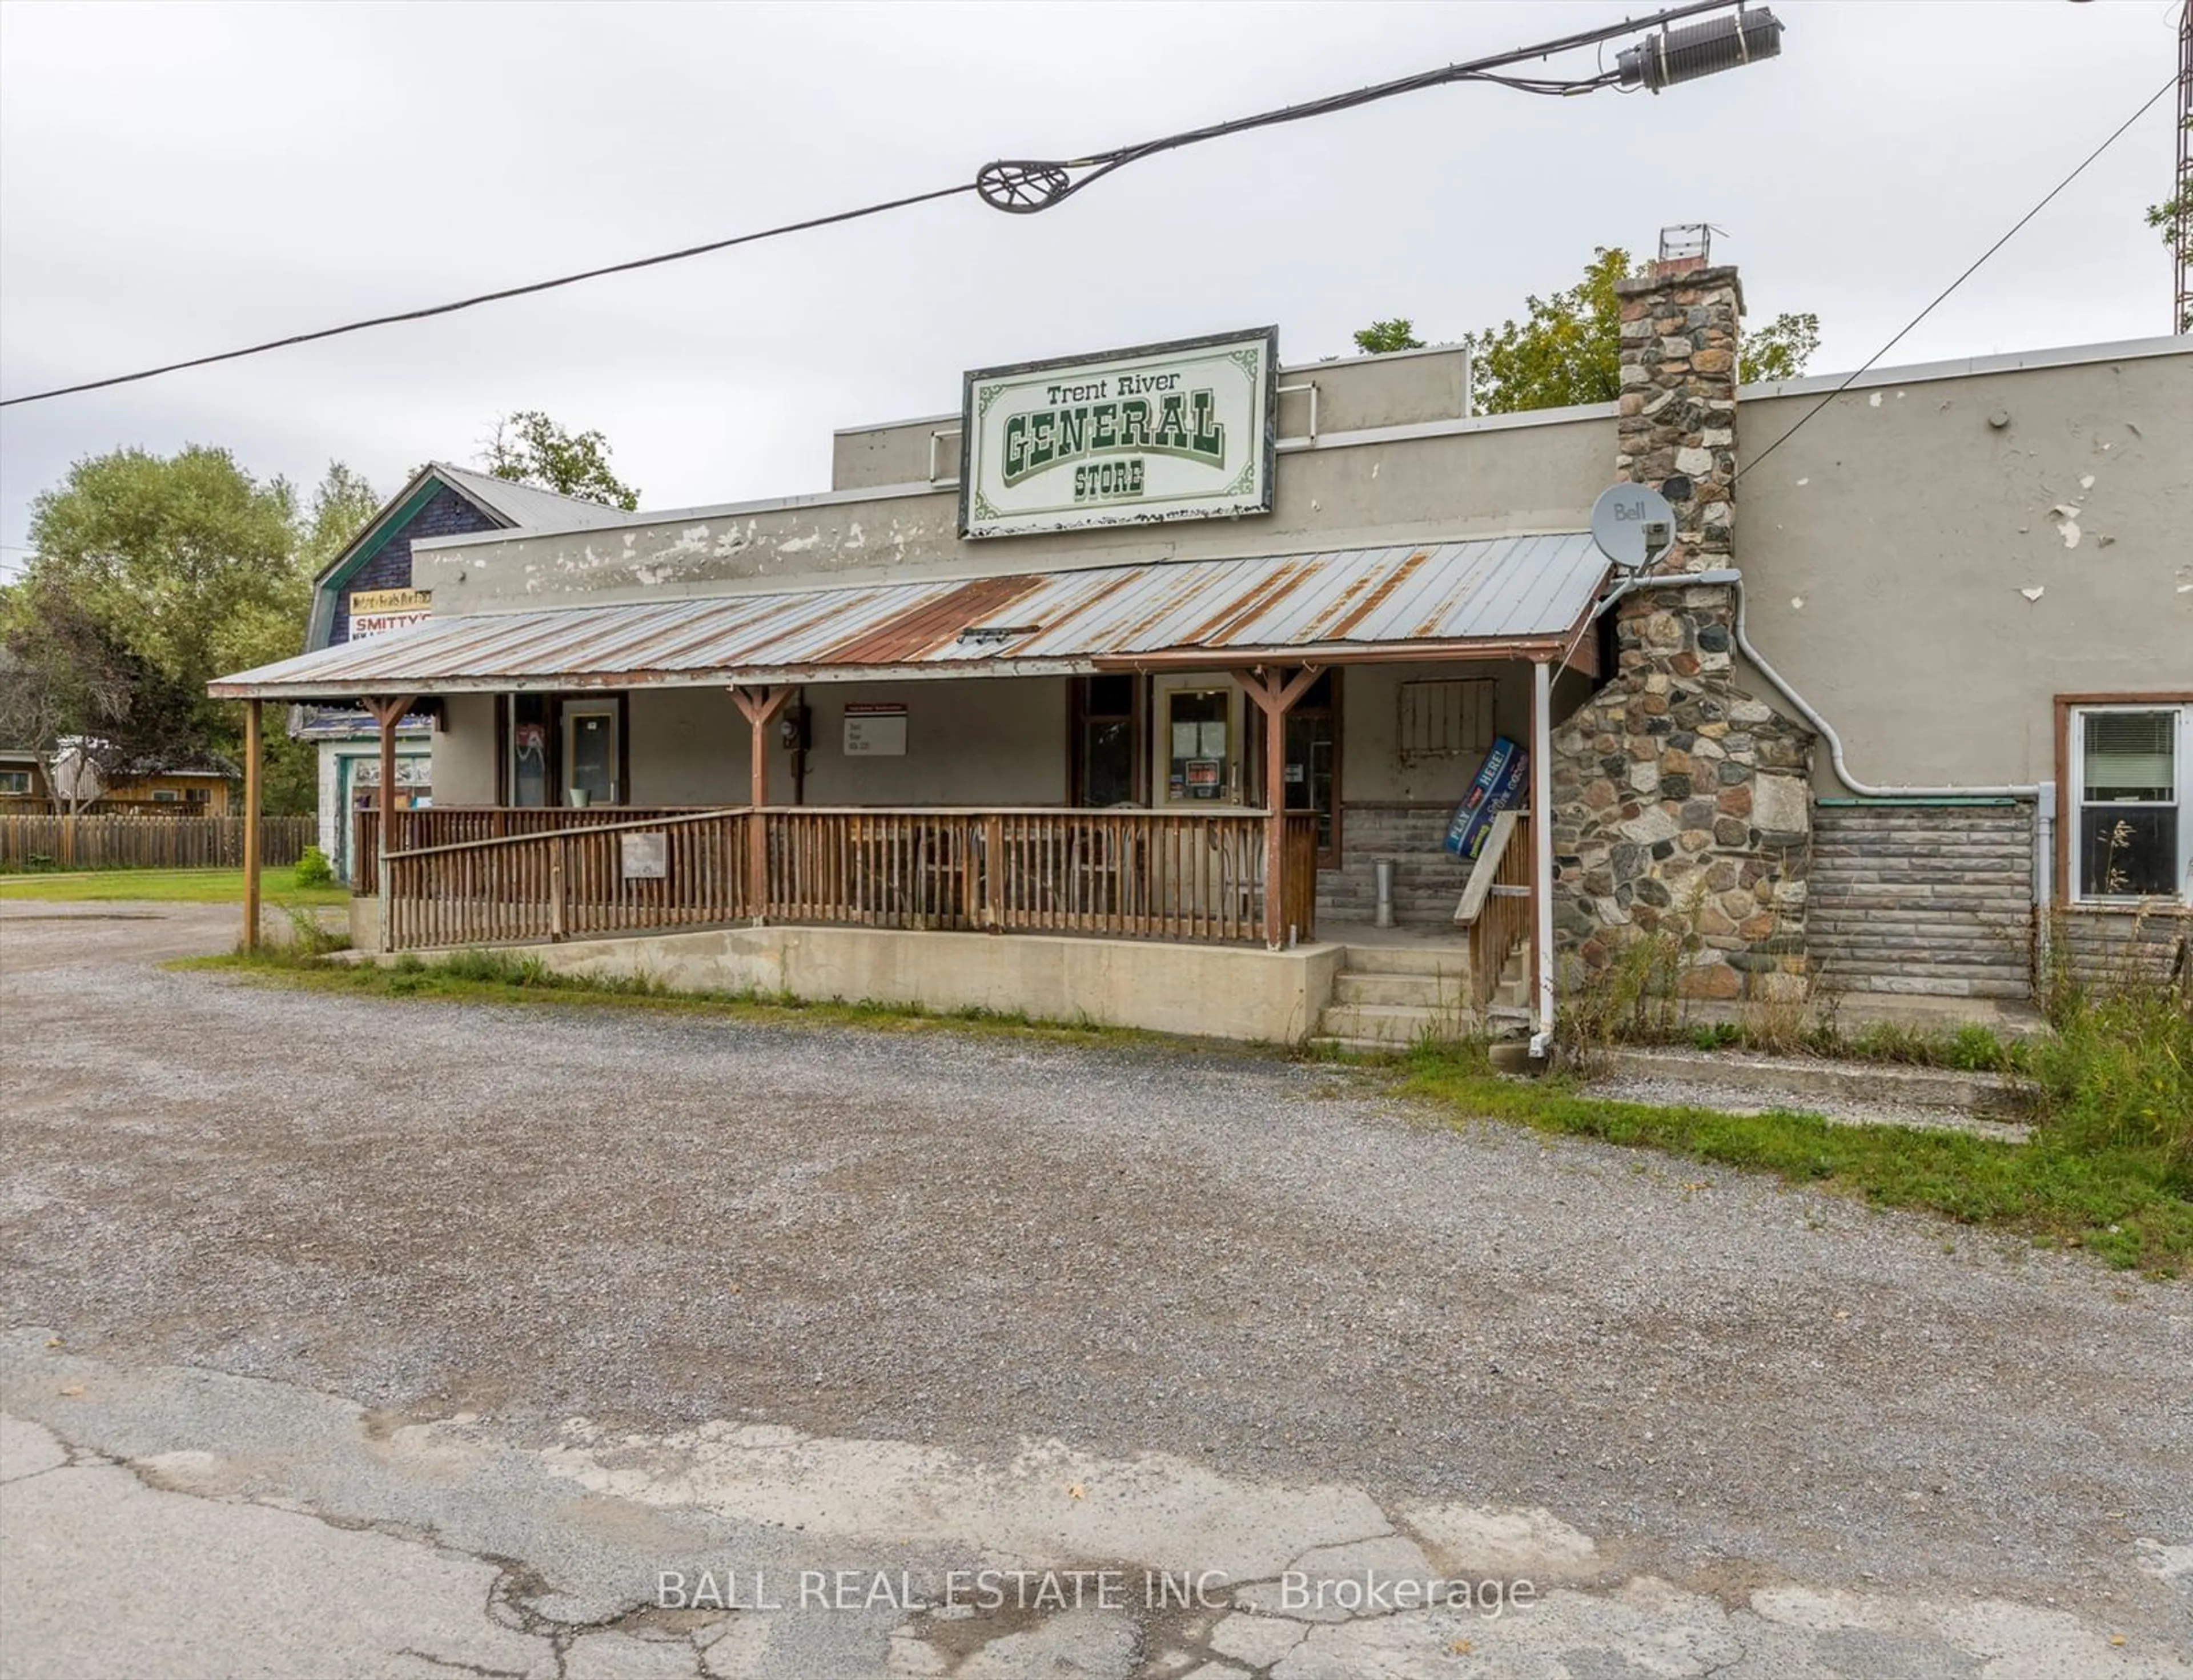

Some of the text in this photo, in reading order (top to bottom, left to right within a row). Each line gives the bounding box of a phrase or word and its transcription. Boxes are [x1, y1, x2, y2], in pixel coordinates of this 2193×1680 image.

[1047, 373, 1181, 405] Trent River
[1003, 388, 1224, 482] GENERAL
[1074, 459, 1144, 500] STORE
[1613, 501, 1646, 521] Bell
[1449, 810, 1471, 841] PLAY
[1479, 749, 1505, 786] HERE!
